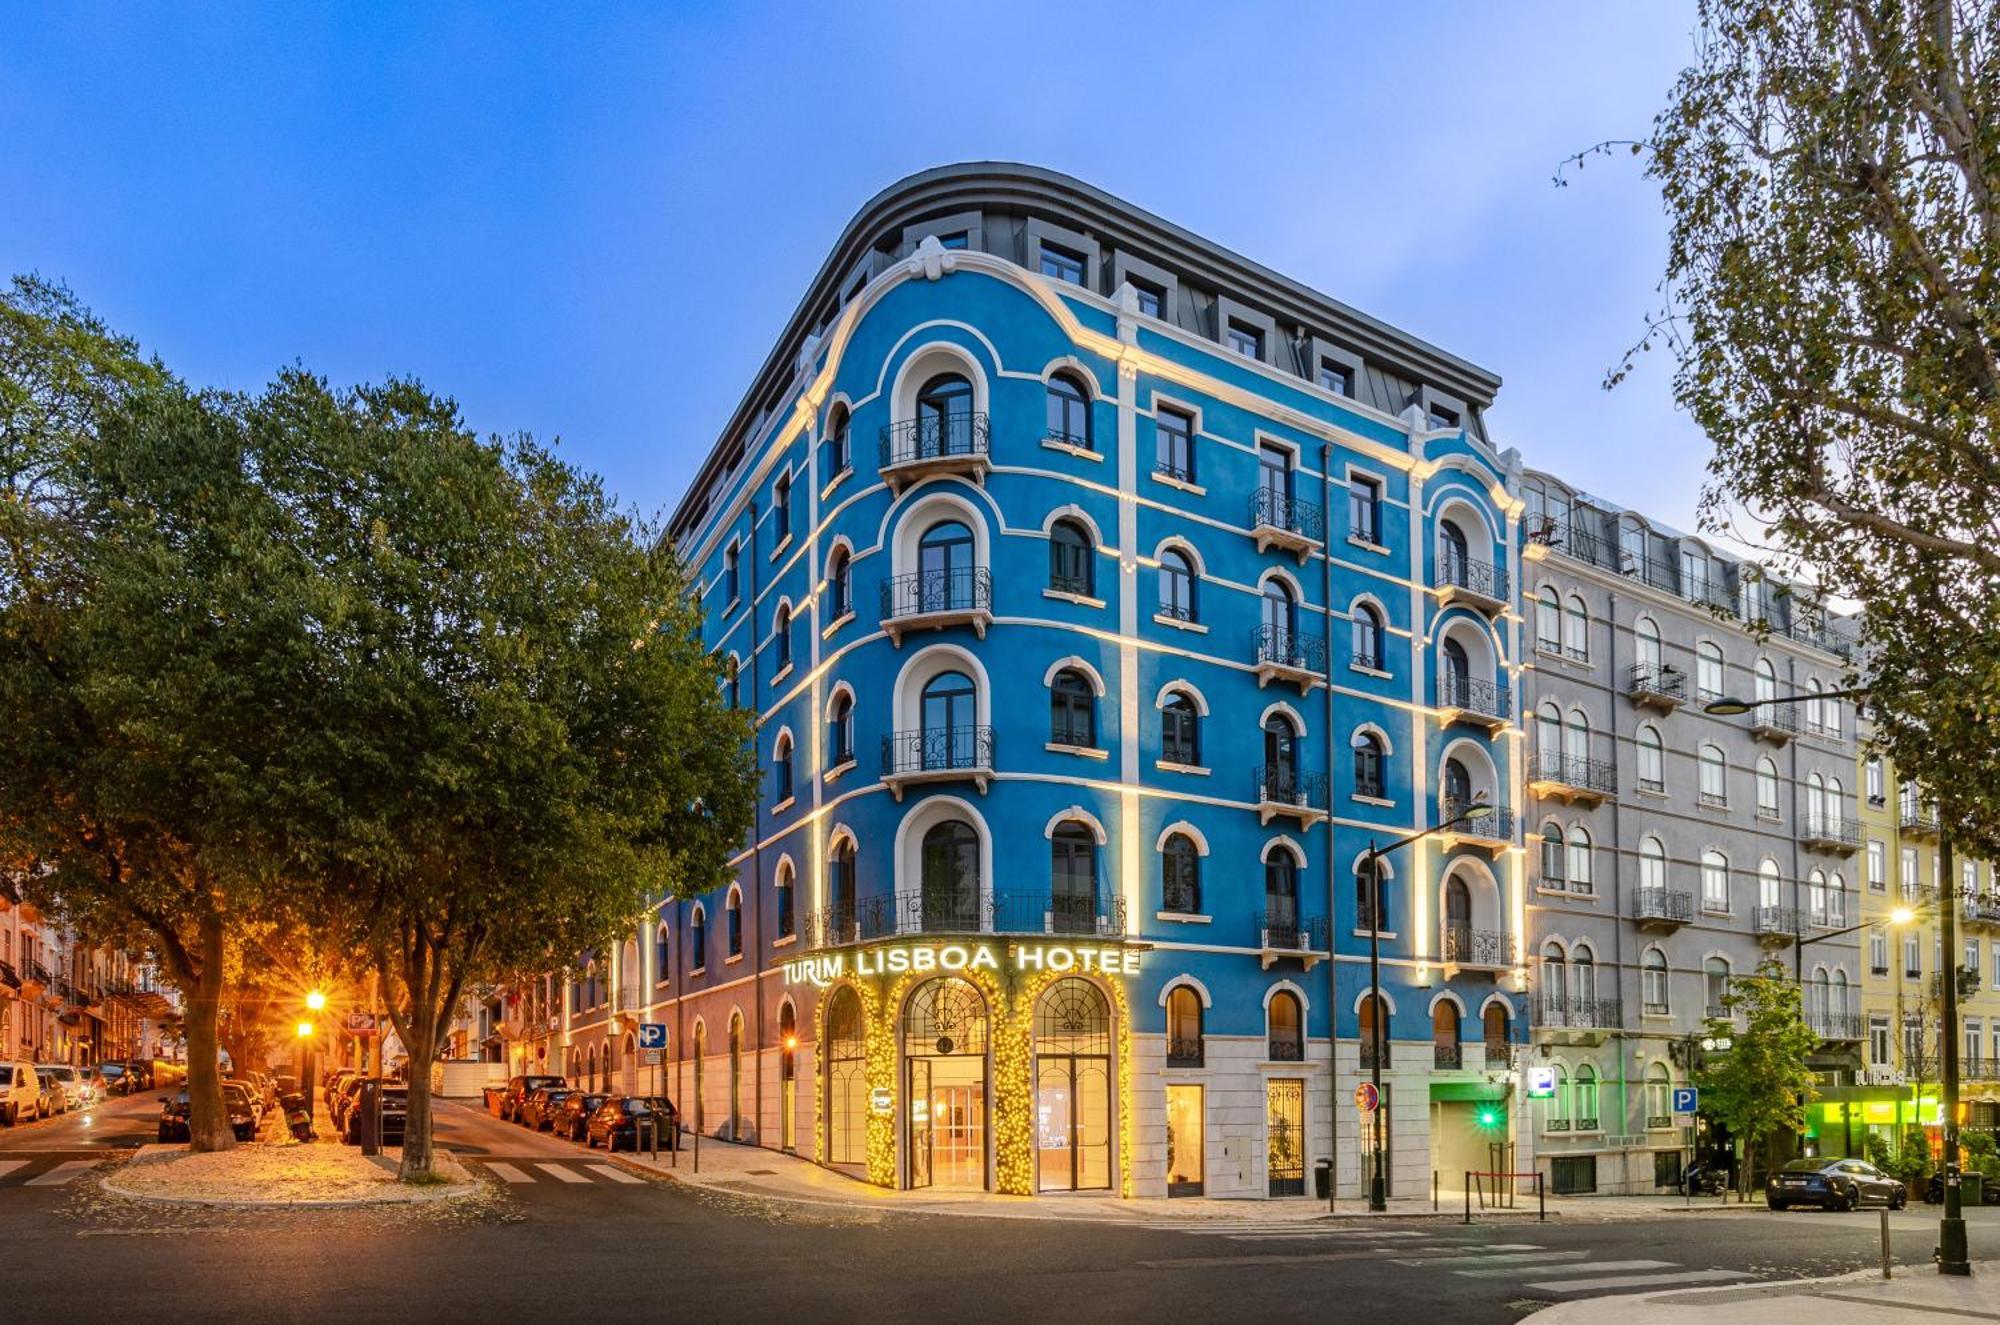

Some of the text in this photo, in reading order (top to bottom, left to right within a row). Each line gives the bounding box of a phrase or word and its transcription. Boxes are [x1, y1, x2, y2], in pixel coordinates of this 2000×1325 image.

[783, 956, 842, 987] TURIM
[857, 945, 998, 975] LISBOA
[645, 1026, 660, 1045] P
[1678, 1091, 1691, 1110] P
